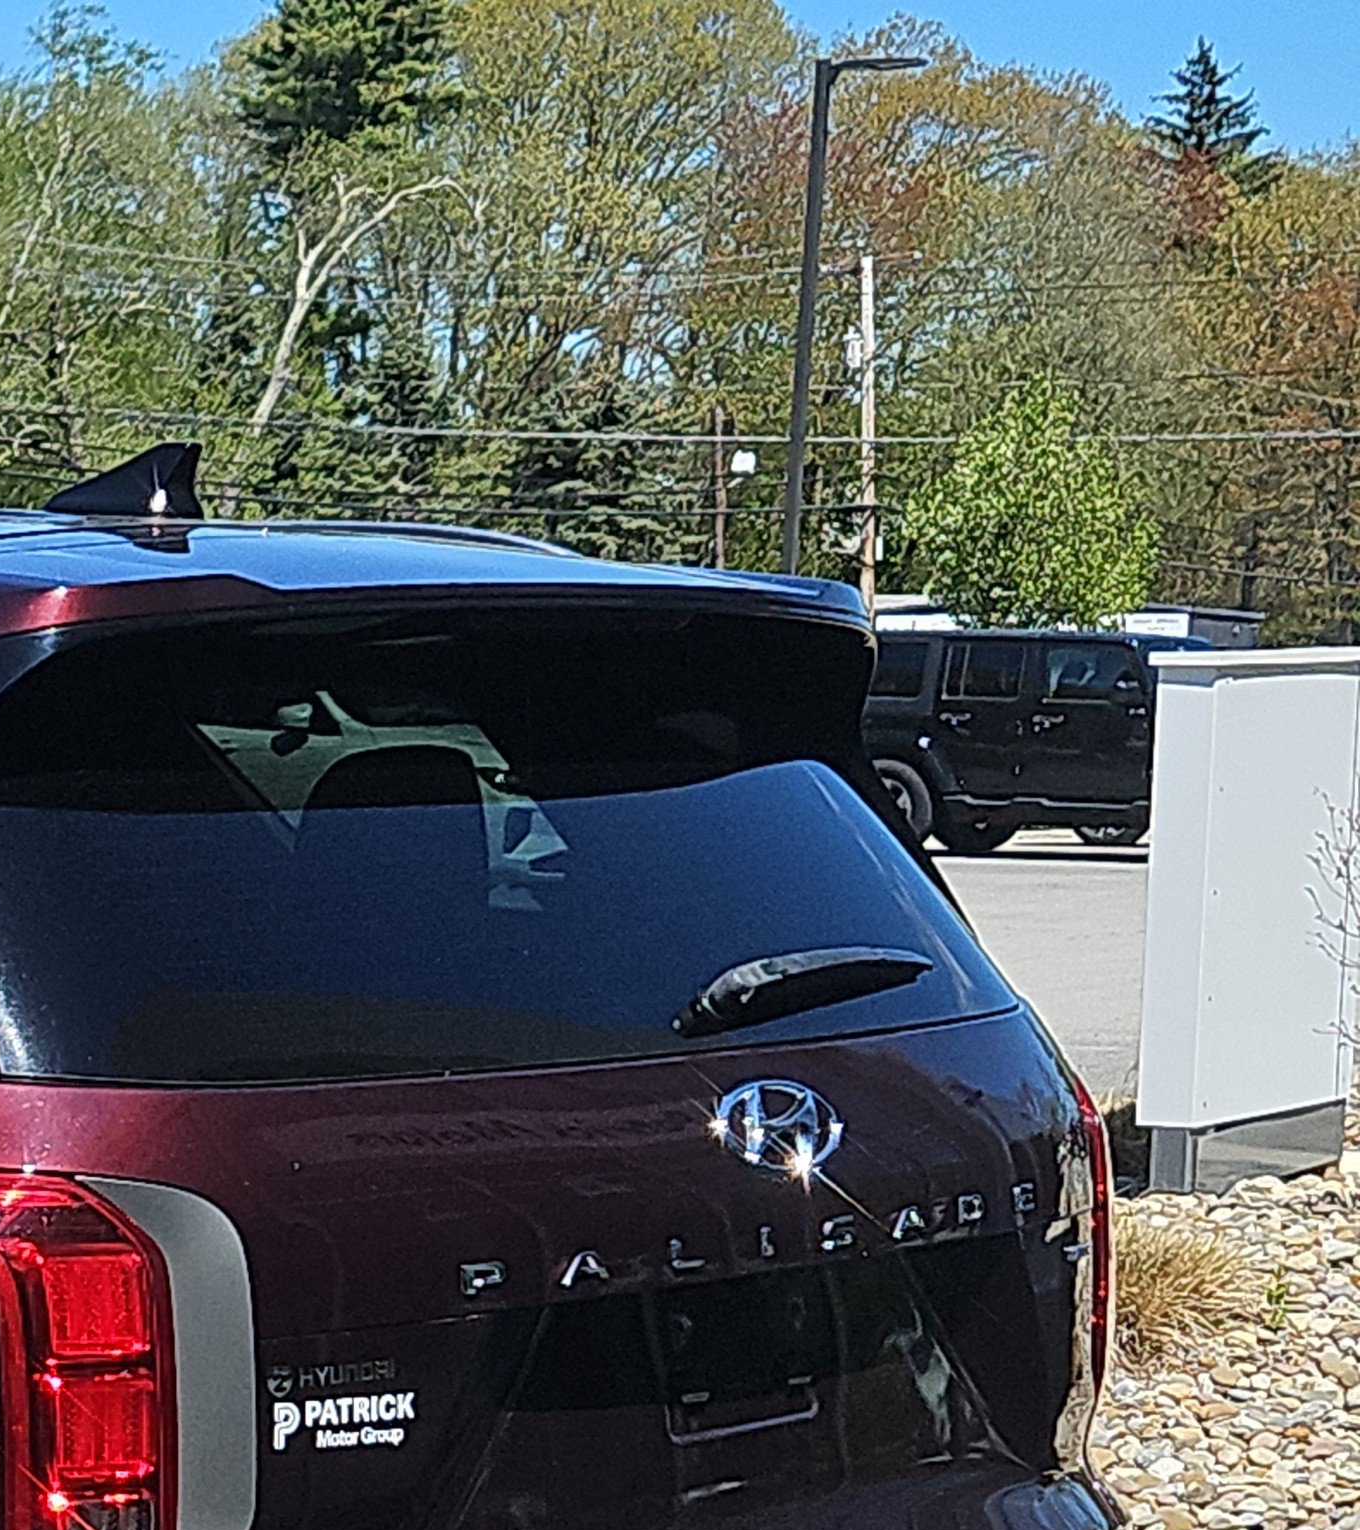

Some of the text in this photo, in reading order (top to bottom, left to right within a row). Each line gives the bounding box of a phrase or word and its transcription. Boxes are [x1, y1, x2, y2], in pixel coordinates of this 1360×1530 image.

[459, 1181, 1036, 1296] PALISADE
[299, 1358, 396, 1388] HYUNDAI
[304, 1392, 416, 1427] PATRICK
[315, 1426, 405, 1448] Motor Group
